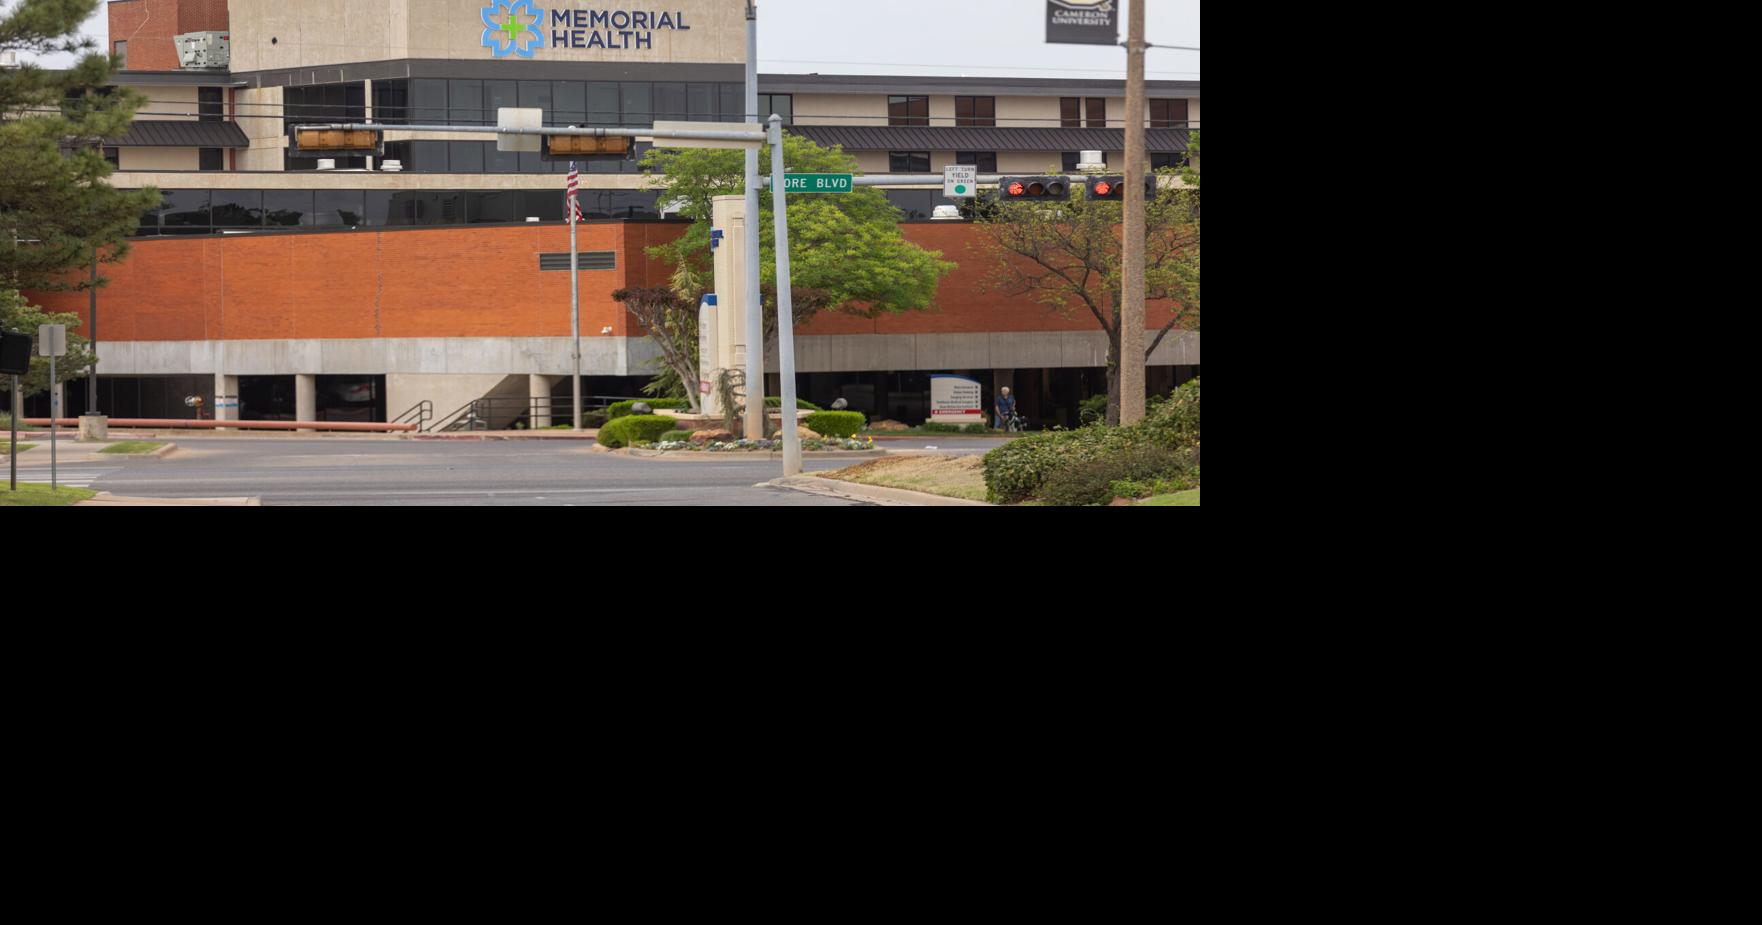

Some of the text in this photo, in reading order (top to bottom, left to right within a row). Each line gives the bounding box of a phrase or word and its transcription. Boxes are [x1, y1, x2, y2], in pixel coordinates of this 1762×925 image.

[551, 9, 690, 30] MEMORIAL
[1052, 16, 1111, 25] UNIVERSITY
[551, 30, 652, 49] HEALTH
[783, 178, 847, 188] ORE BLVD
